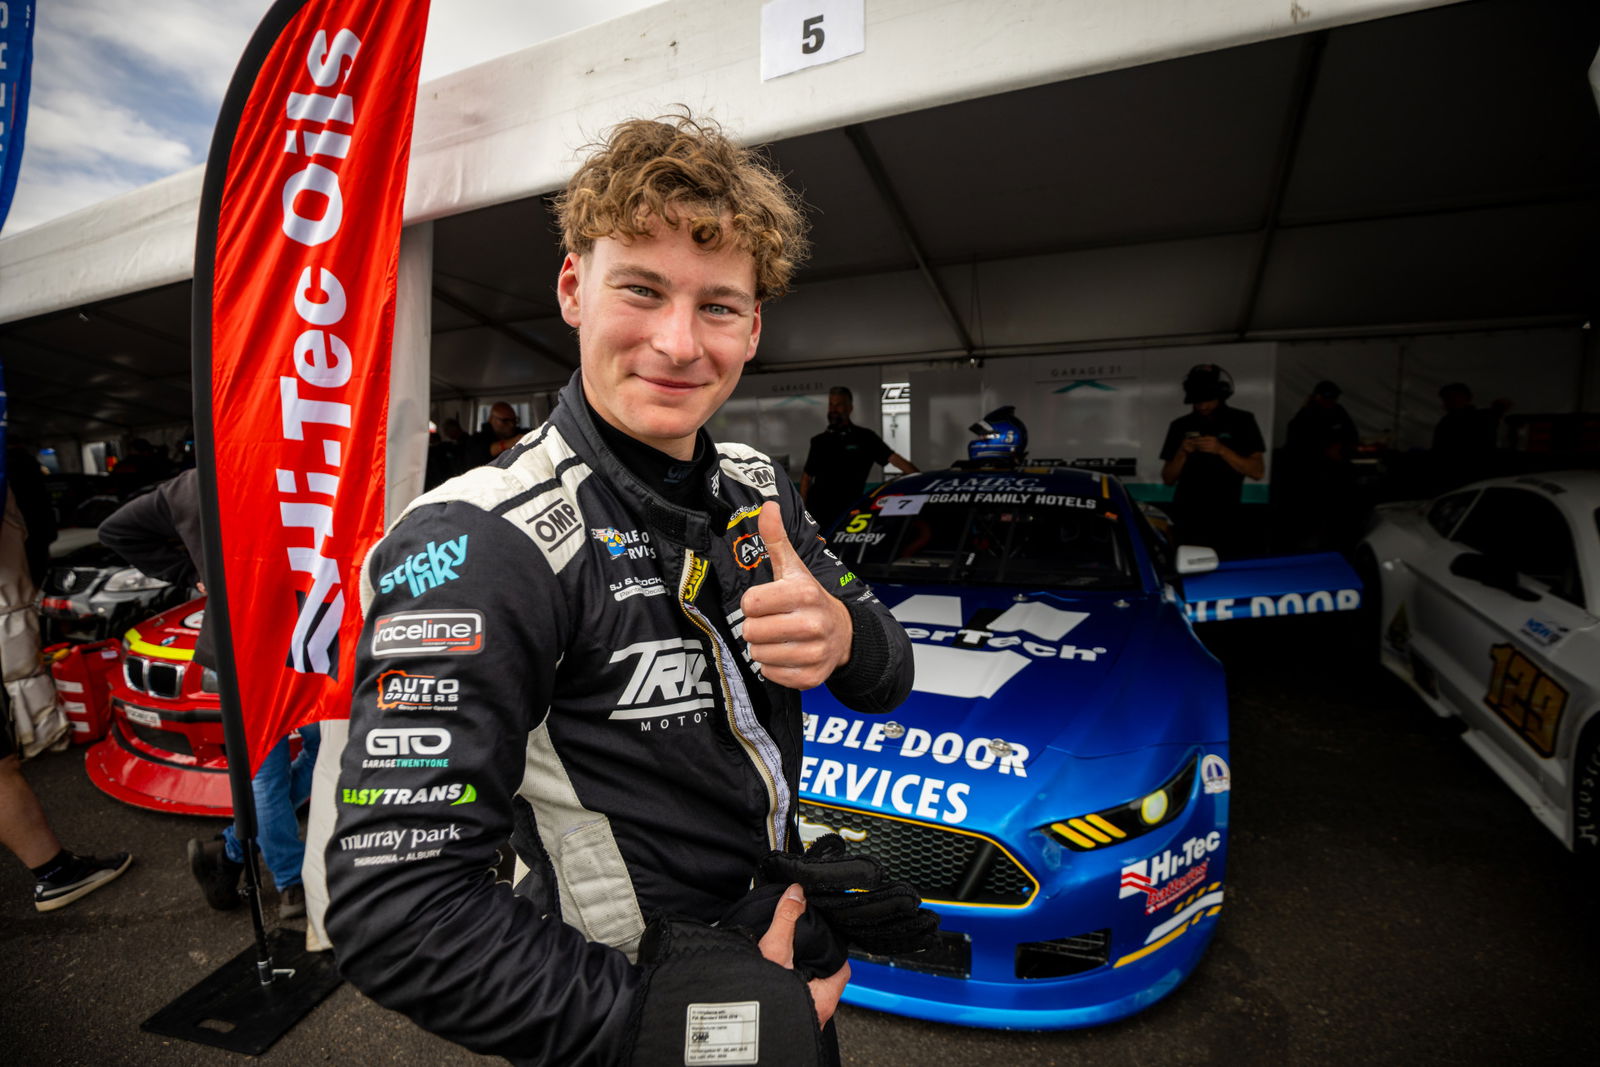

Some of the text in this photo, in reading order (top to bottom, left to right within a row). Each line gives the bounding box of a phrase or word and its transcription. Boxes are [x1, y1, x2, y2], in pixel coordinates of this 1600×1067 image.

[802, 14, 825, 54] 5
[276, 28, 361, 578] Hi-Tec Oils
[1051, 366, 1103, 377] GARAGE
[772, 383, 811, 392] GARAGE
[897, 499, 911, 509] 7
[974, 493, 1031, 504] FAMILY
[1035, 494, 1097, 509] HOTELS
[535, 503, 578, 542] OMP
[846, 514, 872, 533] 5
[833, 531, 886, 545] Tracey
[376, 619, 472, 643] raceline
[388, 678, 459, 694] AUTO
[384, 692, 459, 703] OPENERS
[366, 727, 452, 756] GTO
[362, 758, 449, 768] GARAGETWENTYONE
[900, 728, 1030, 778] DOOR
[342, 783, 463, 805] EASYTRANS
[799, 756, 971, 824] ERVICES
[340, 824, 462, 851] murray park
